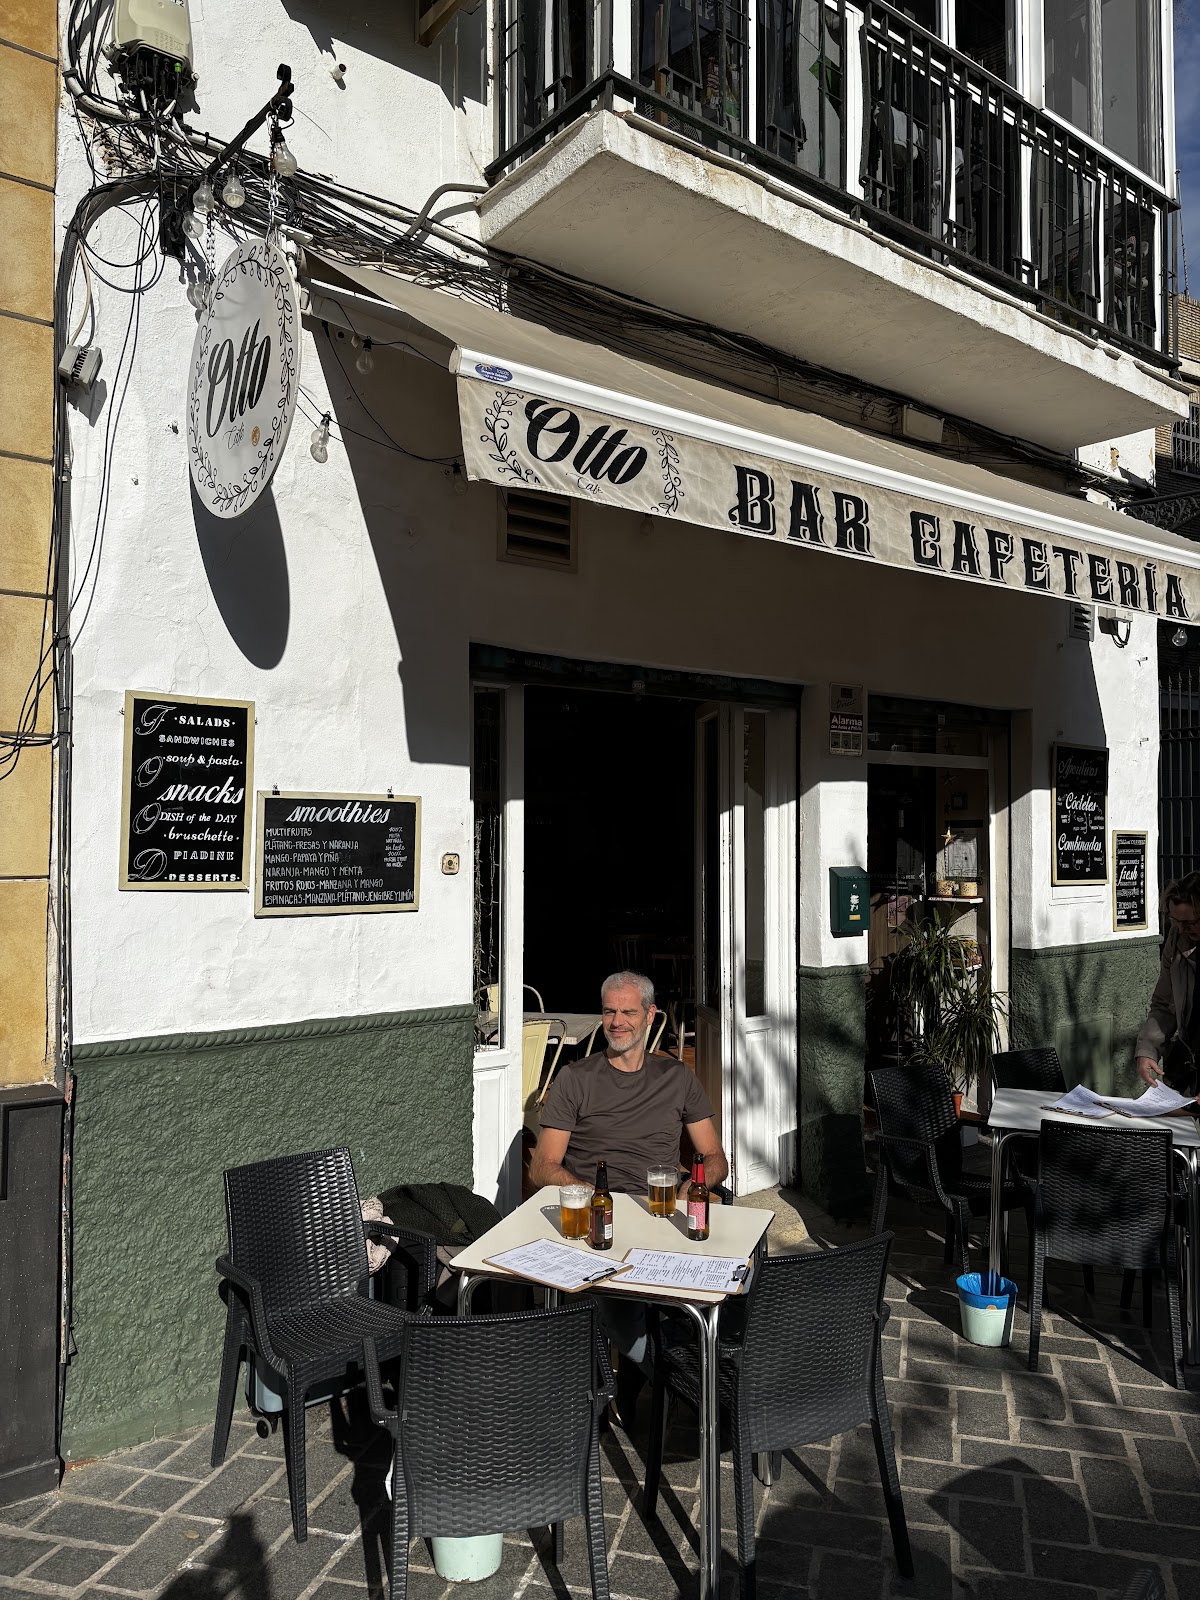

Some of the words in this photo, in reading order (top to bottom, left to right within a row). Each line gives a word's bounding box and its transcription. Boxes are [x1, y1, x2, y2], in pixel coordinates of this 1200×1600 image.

[207, 318, 271, 439] Otto
[524, 398, 648, 485] Otto
[728, 464, 875, 558] BAR
[908, 510, 1190, 621] CAFETERÍA
[831, 714, 863, 726] Alarma
[158, 734, 236, 747] SANDWICHES
[166, 754, 195, 767] soup
[197, 755, 206, 765] &
[206, 754, 240, 768] pasta
[1058, 757, 1099, 779] Aperitivos
[157, 776, 245, 804] snacks
[1065, 791, 1097, 812] Cócteles
[159, 811, 184, 822] DISH
[186, 813, 197, 824] of
[199, 813, 212, 822] the
[215, 813, 237, 823] DAY
[286, 802, 391, 823] smoothies
[168, 826, 234, 842] bruschette
[266, 827, 313, 837] MULTIFRUTAS
[322, 840, 328, 849] Y
[329, 840, 359, 849] NARANJA
[1058, 833, 1102, 851] Combinados
[173, 850, 234, 860] PIADINE
[332, 866, 337, 877] Y
[339, 865, 363, 876] MENTA
[1116, 865, 1138, 886] fresh
[265, 880, 294, 891] FRUTOS
[353, 878, 359, 888] Y
[359, 878, 384, 889] MANGO
